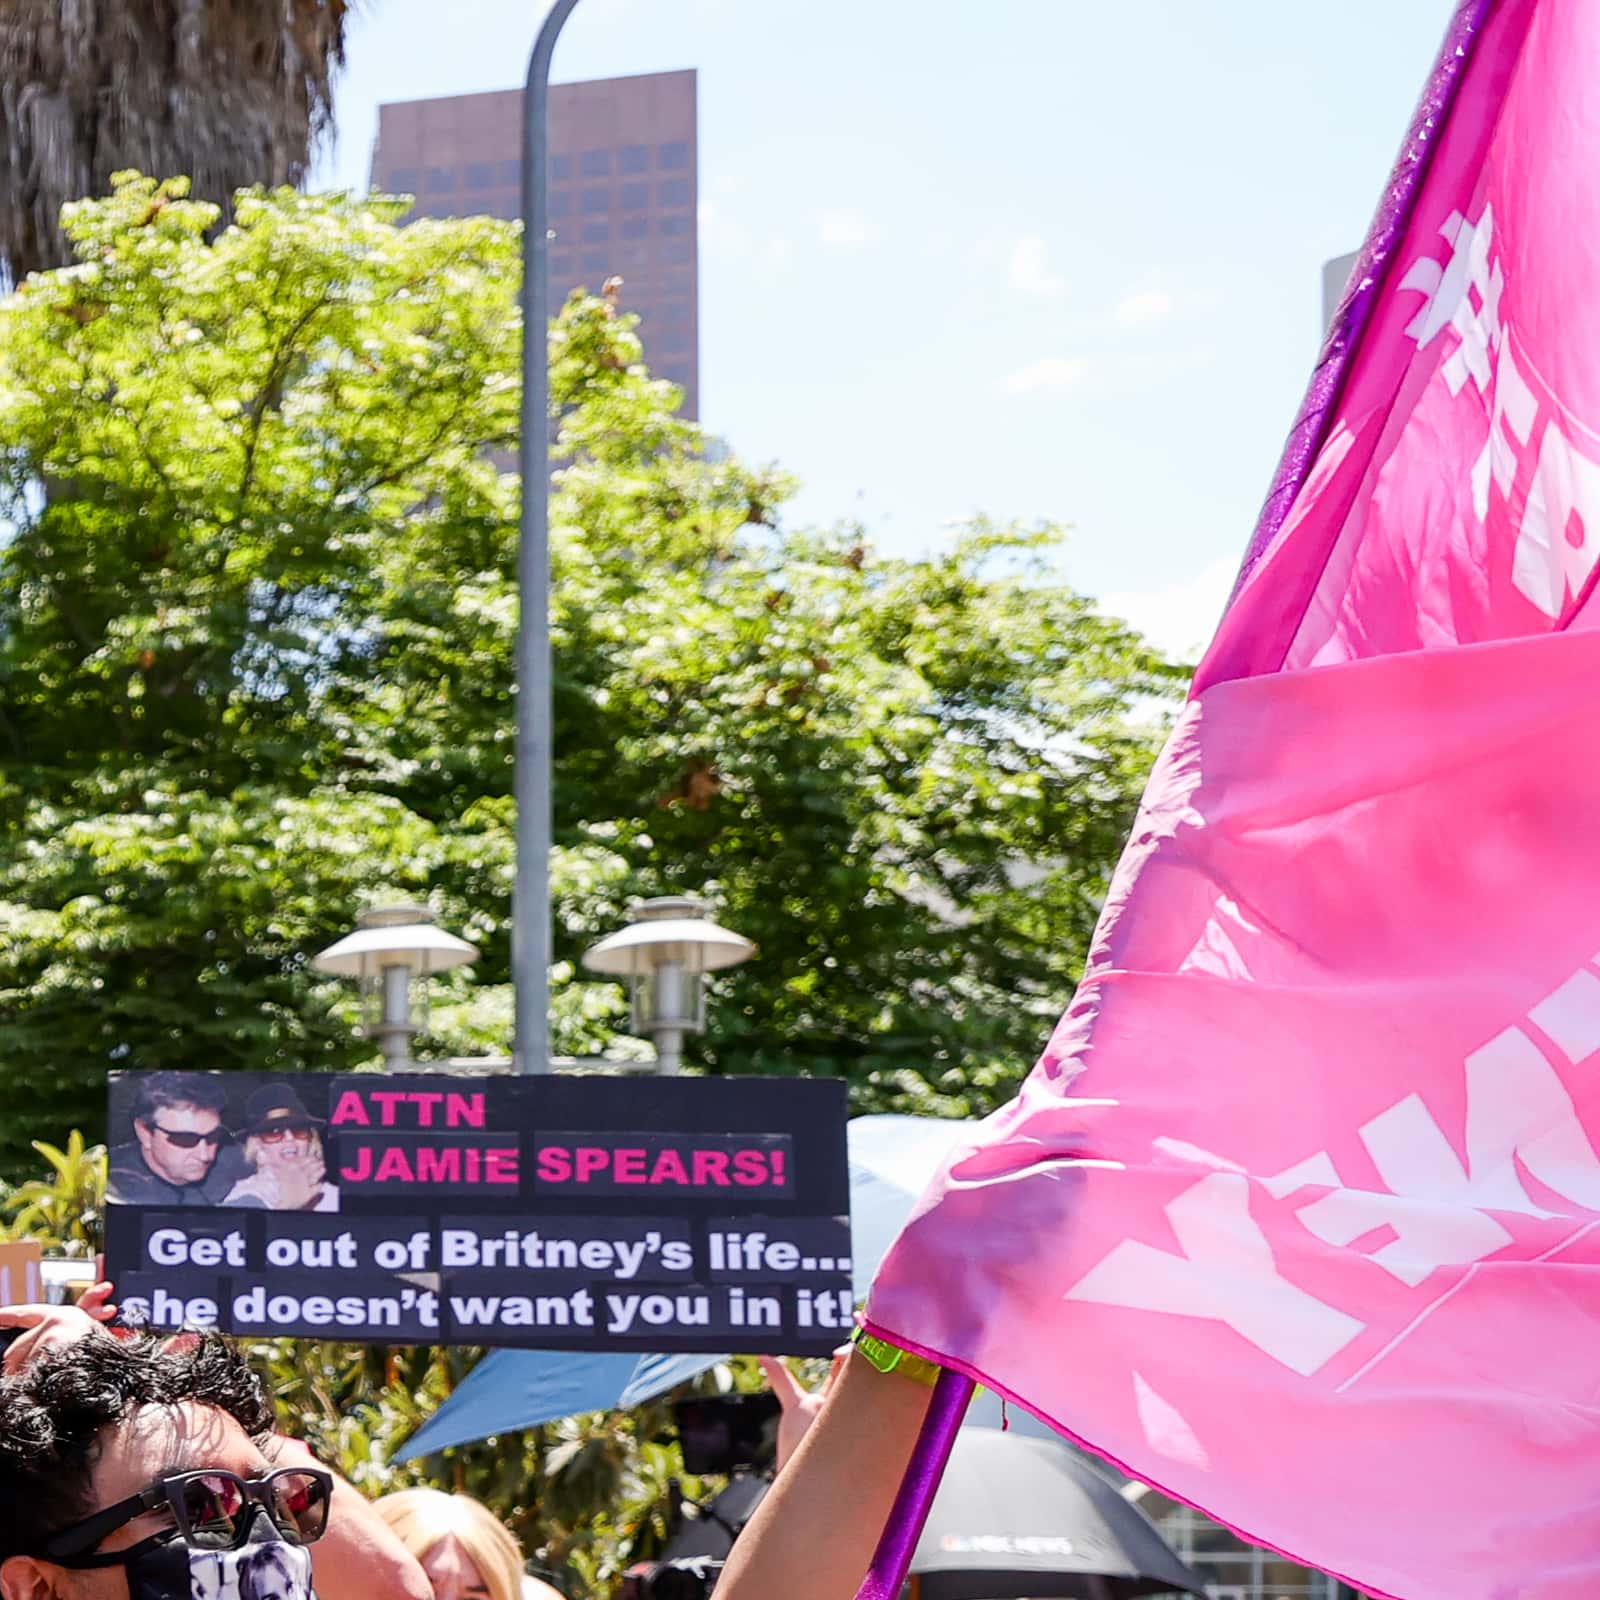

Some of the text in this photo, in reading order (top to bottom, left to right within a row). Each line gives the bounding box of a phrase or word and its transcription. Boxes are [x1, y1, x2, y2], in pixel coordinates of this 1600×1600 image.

[331, 1091, 487, 1129] ATTN
[339, 1146, 786, 1187] JAMIE SPEARS!
[148, 1228, 247, 1269] Get
[266, 1232, 357, 1270] out
[374, 1230, 430, 1271] of
[442, 1228, 693, 1281] Britney's
[120, 1285, 855, 1334] she doesn't want you in it!
